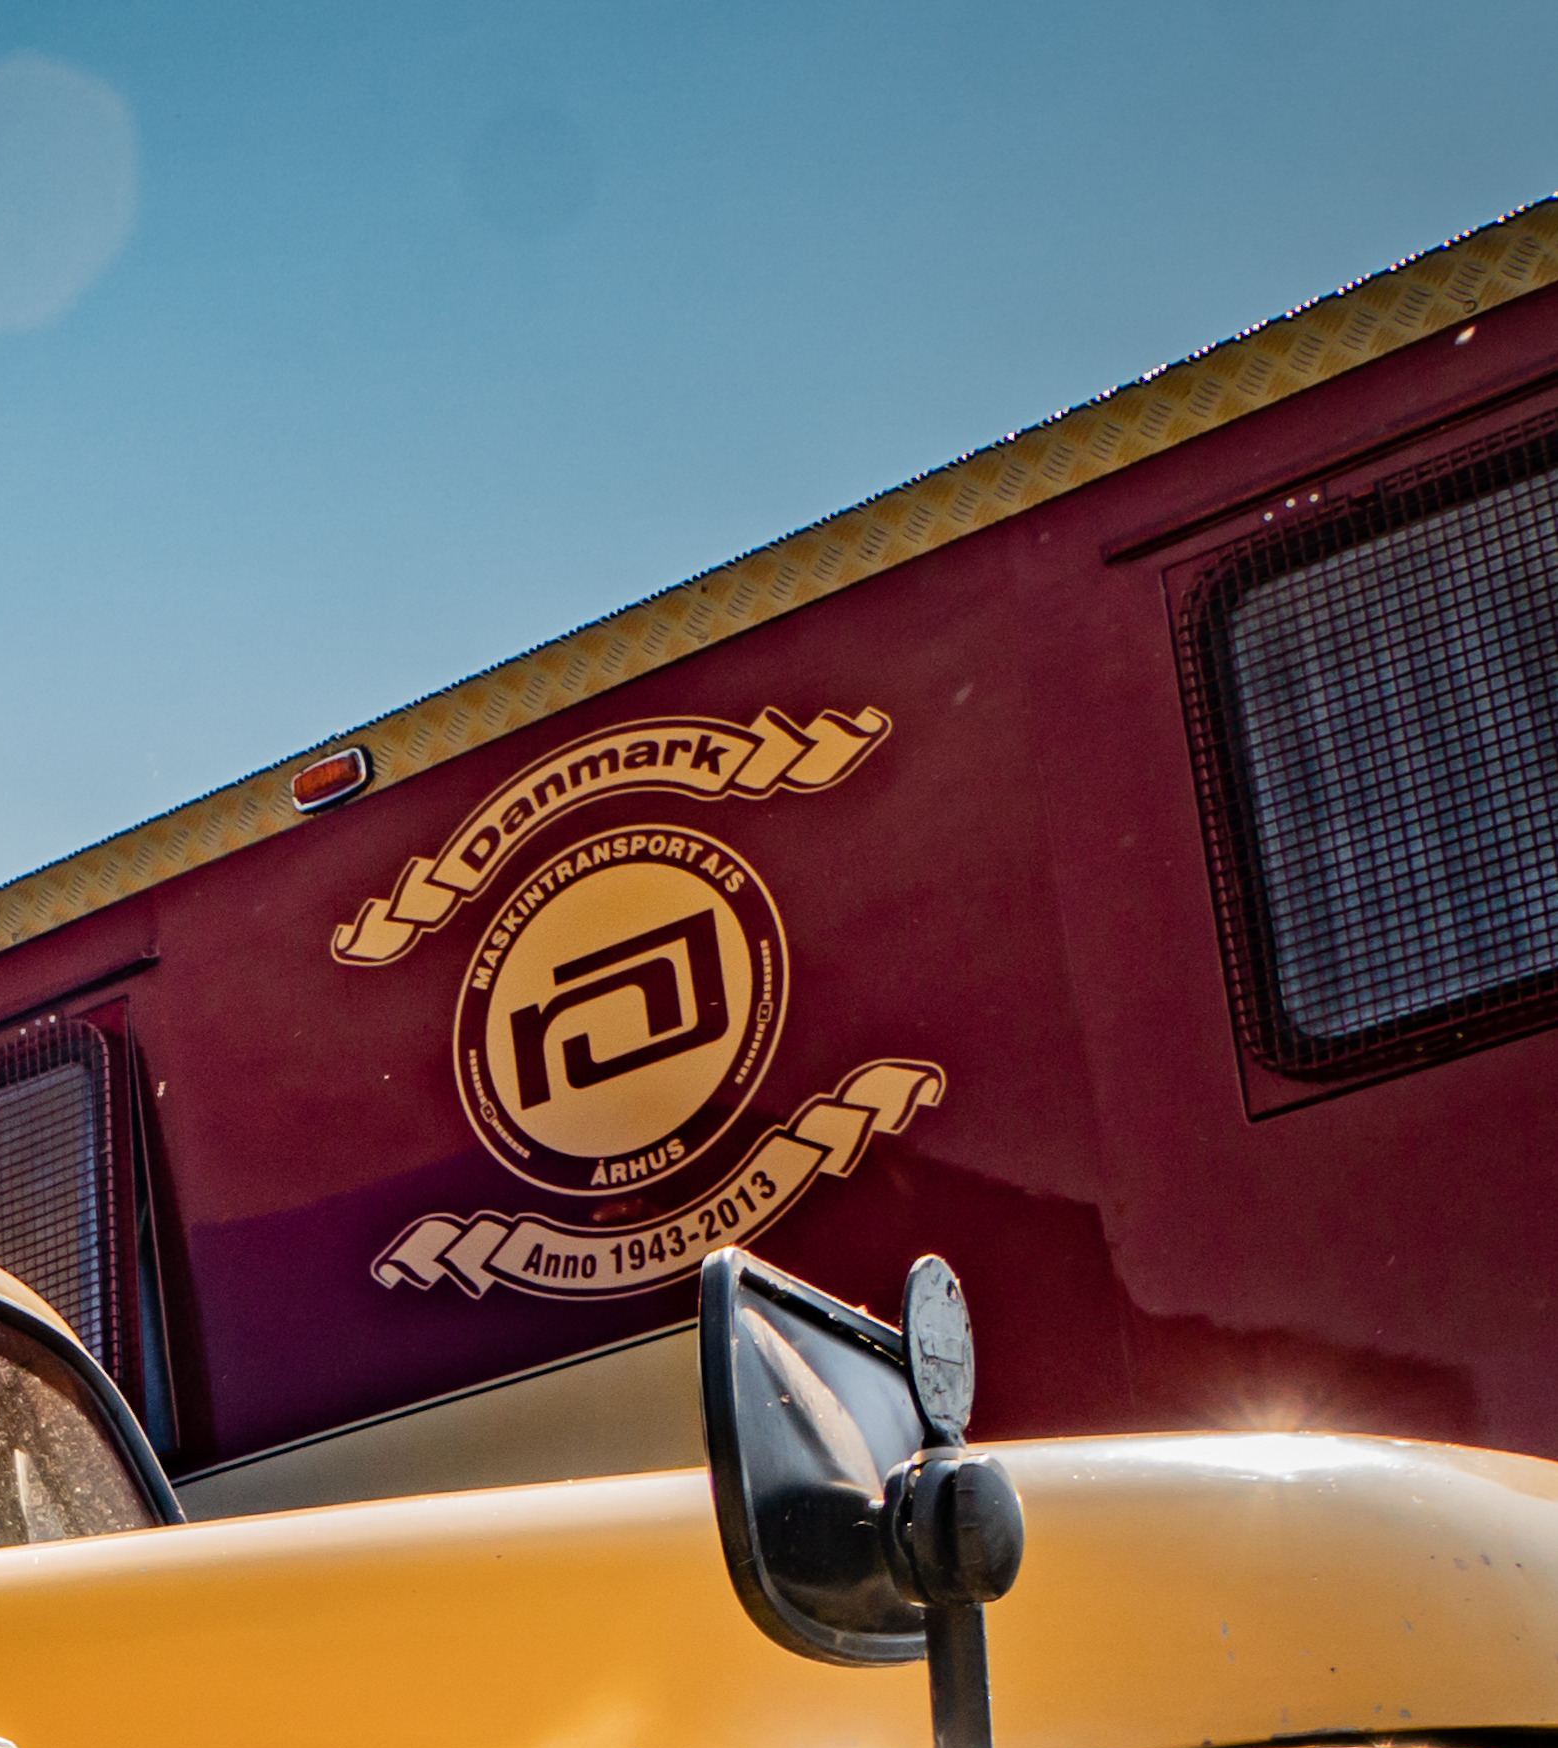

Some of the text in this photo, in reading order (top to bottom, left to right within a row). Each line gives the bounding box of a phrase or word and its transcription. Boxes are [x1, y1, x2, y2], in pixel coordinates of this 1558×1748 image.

[460, 734, 731, 873] Danmark
[472, 834, 746, 991] MASKINTRANSPORT A/S
[590, 1137, 686, 1186] ÅRHUS
[521, 1170, 778, 1279] Anno 1943-2013
